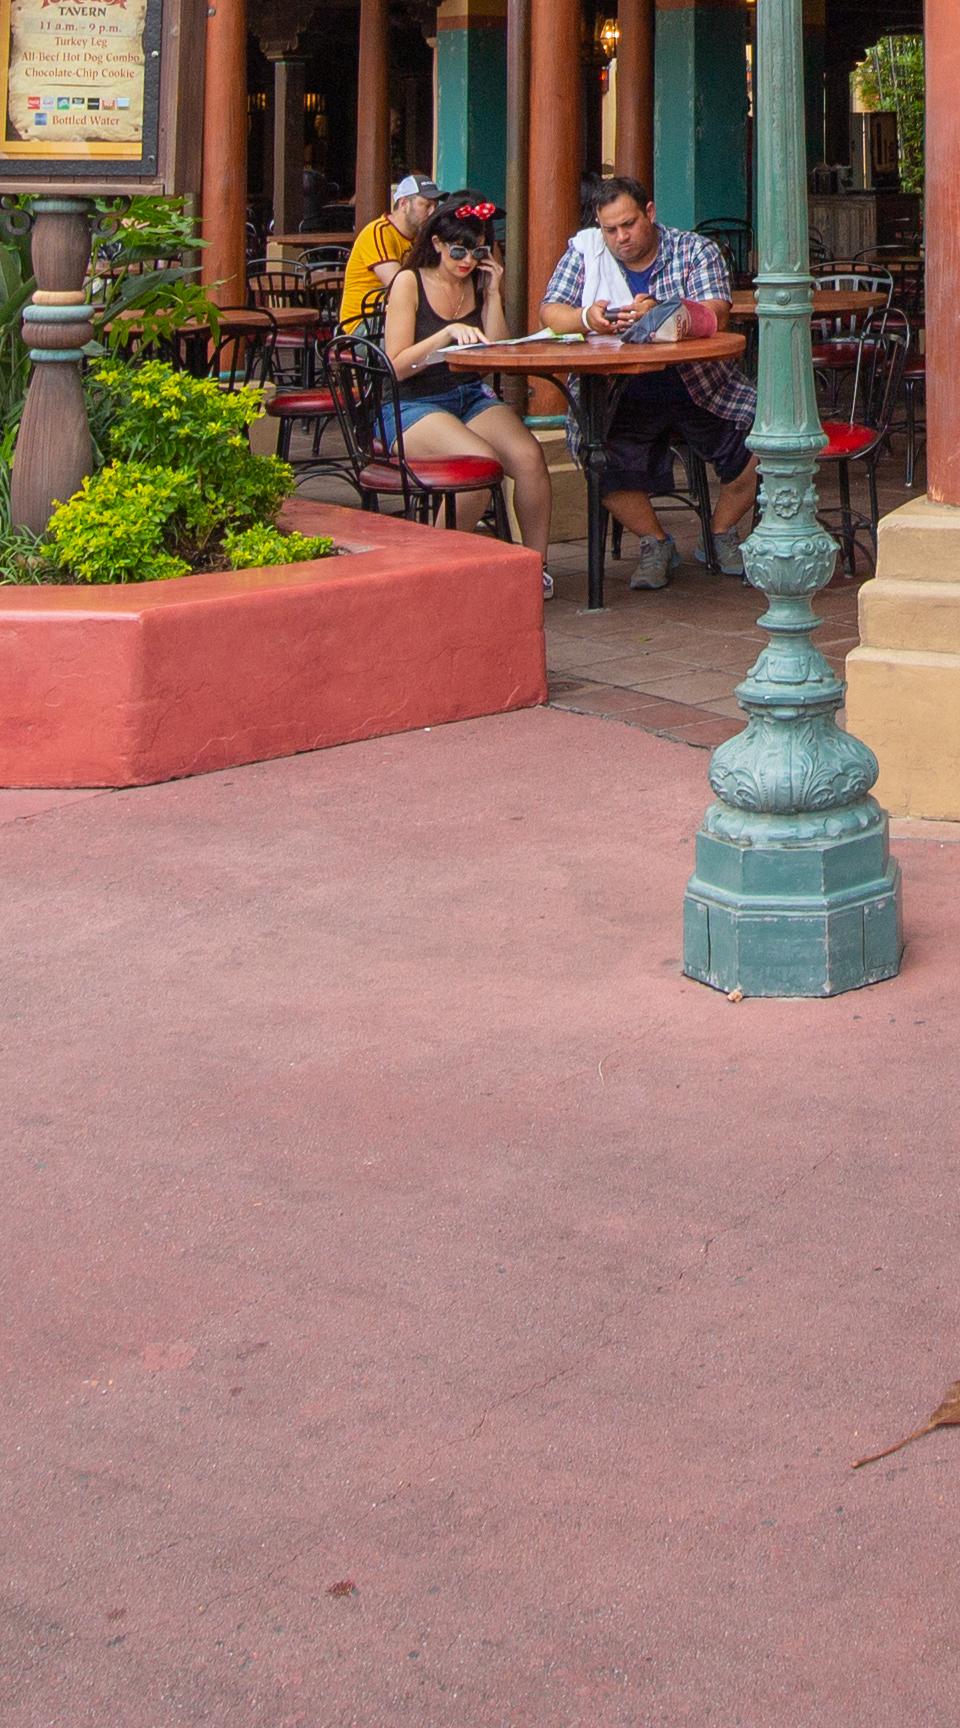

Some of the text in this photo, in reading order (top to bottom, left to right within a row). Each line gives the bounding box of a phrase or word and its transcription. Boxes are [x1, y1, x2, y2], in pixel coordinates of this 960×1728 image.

[59, 7, 106, 17] TAVERN
[40, 21, 51, 30] 11
[55, 23, 78, 31] a.m.
[89, 23, 96, 31] 9
[99, 24, 122, 35] p.m.
[55, 36, 108, 48] Turkey Leg
[63, 52, 81, 62] Hot
[84, 52, 103, 64] Dog
[106, 52, 140, 63] Combo
[25, 67, 135, 80] Chocolate-Chip Cookie
[52, 115, 87, 125] Bottled
[90, 116, 120, 125] Water
